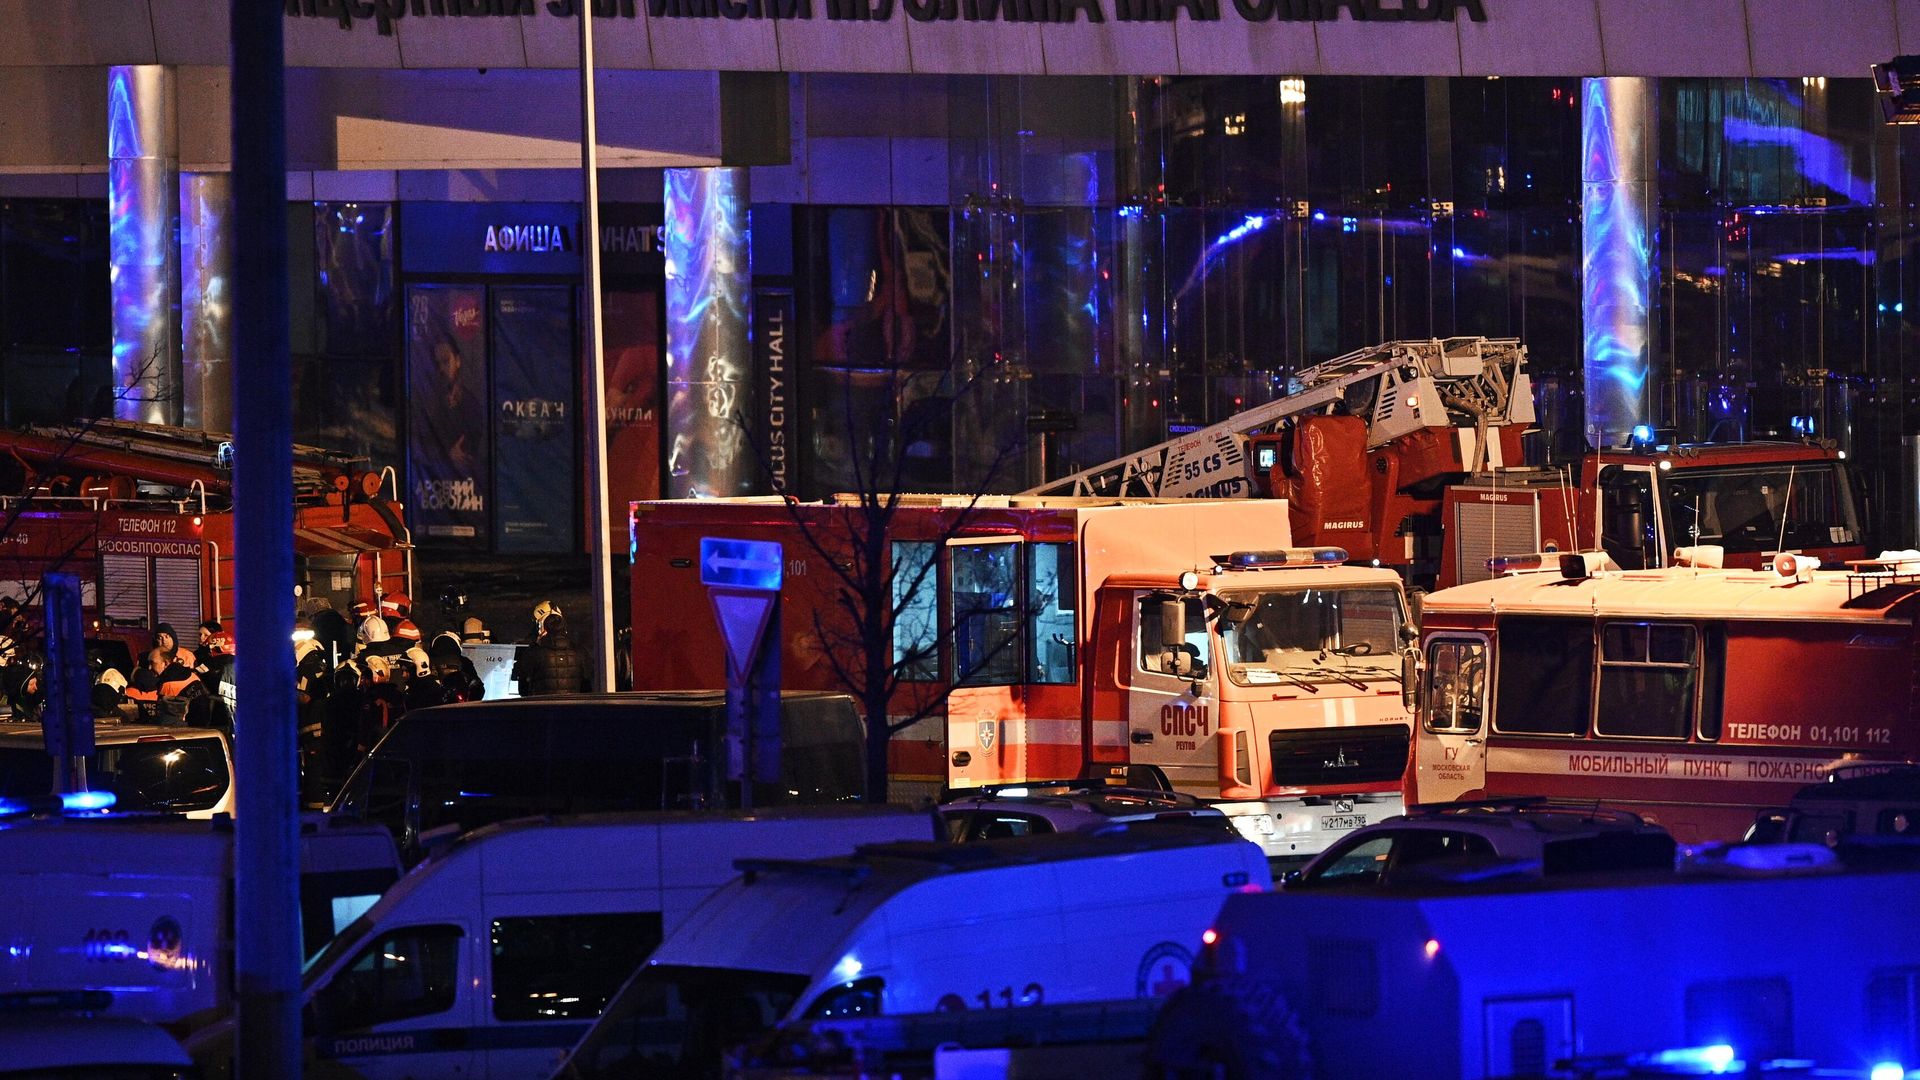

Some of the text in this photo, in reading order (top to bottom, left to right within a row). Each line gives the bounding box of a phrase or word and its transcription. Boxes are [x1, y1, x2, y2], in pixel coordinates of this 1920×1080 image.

[484, 225, 565, 251] АФИША
[769, 310, 784, 372] HALL
[770, 376, 785, 427] CITY
[1184, 453, 1222, 480] 55 CS
[1178, 480, 1241, 498] AGIRUS
[1480, 493, 1508, 502] MAGIRUS
[118, 518, 176, 533] ТЕЛЕФОН 112
[1323, 520, 1364, 530] MAGIRUS
[1161, 704, 1209, 736] СПСЧ
[1728, 723, 1890, 744] ТЕЛЕФОН 01,101 112
[1176, 741, 1196, 751] РЕУТОВ
[1445, 747, 1459, 760] ГУ
[1432, 764, 1471, 772] МОСКОВСКАЯ
[1568, 754, 1669, 775] МОБИЛЬНЫЙ
[1683, 760, 1732, 777] ПУНКТ
[335, 1036, 415, 1055] ПОЛИЦИЯ
